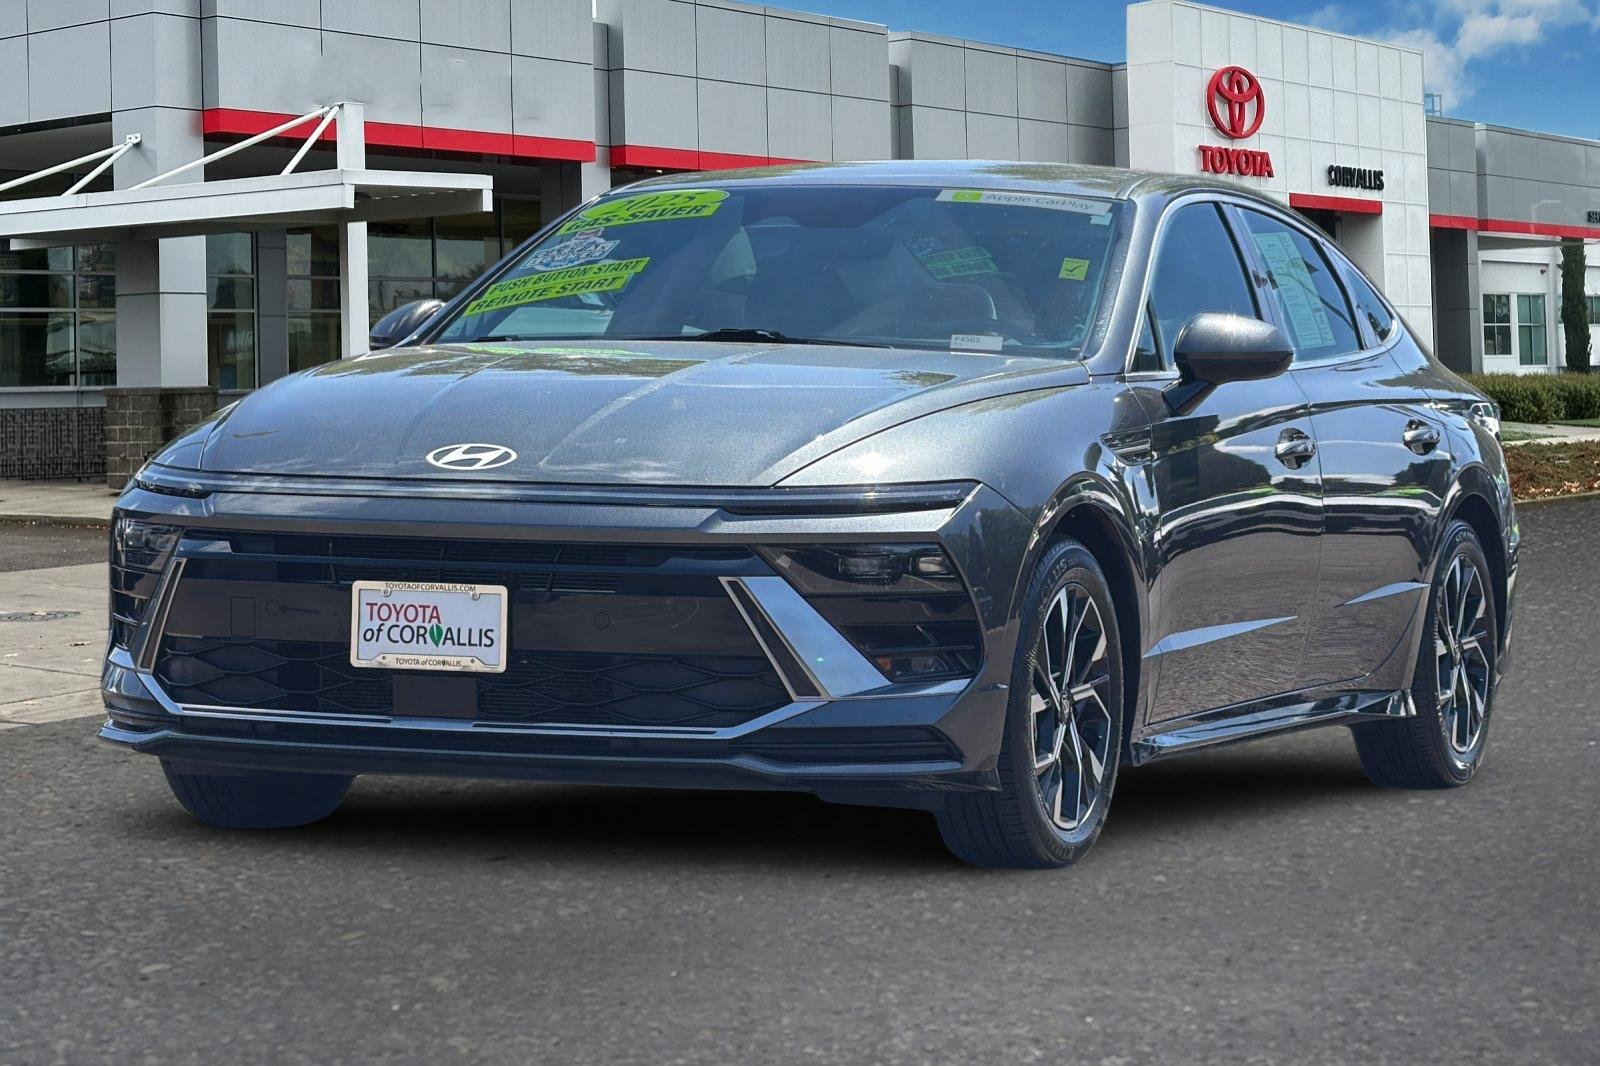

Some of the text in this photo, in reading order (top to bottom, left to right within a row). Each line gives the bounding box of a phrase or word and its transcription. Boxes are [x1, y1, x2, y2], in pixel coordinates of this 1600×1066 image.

[1199, 145, 1274, 178] TOYOTA
[1327, 165, 1384, 190] CORVALLIS
[987, 194, 1094, 210] Apple CarPlay
[489, 259, 645, 295] PUSH BUTTON START
[469, 276, 619, 312] REMOTE START
[385, 582, 476, 592] TOYOTAOFCORVALLIS.COM
[366, 602, 442, 624] TOYOTA
[363, 623, 385, 642] of
[395, 657, 420, 666] TOYOTA
